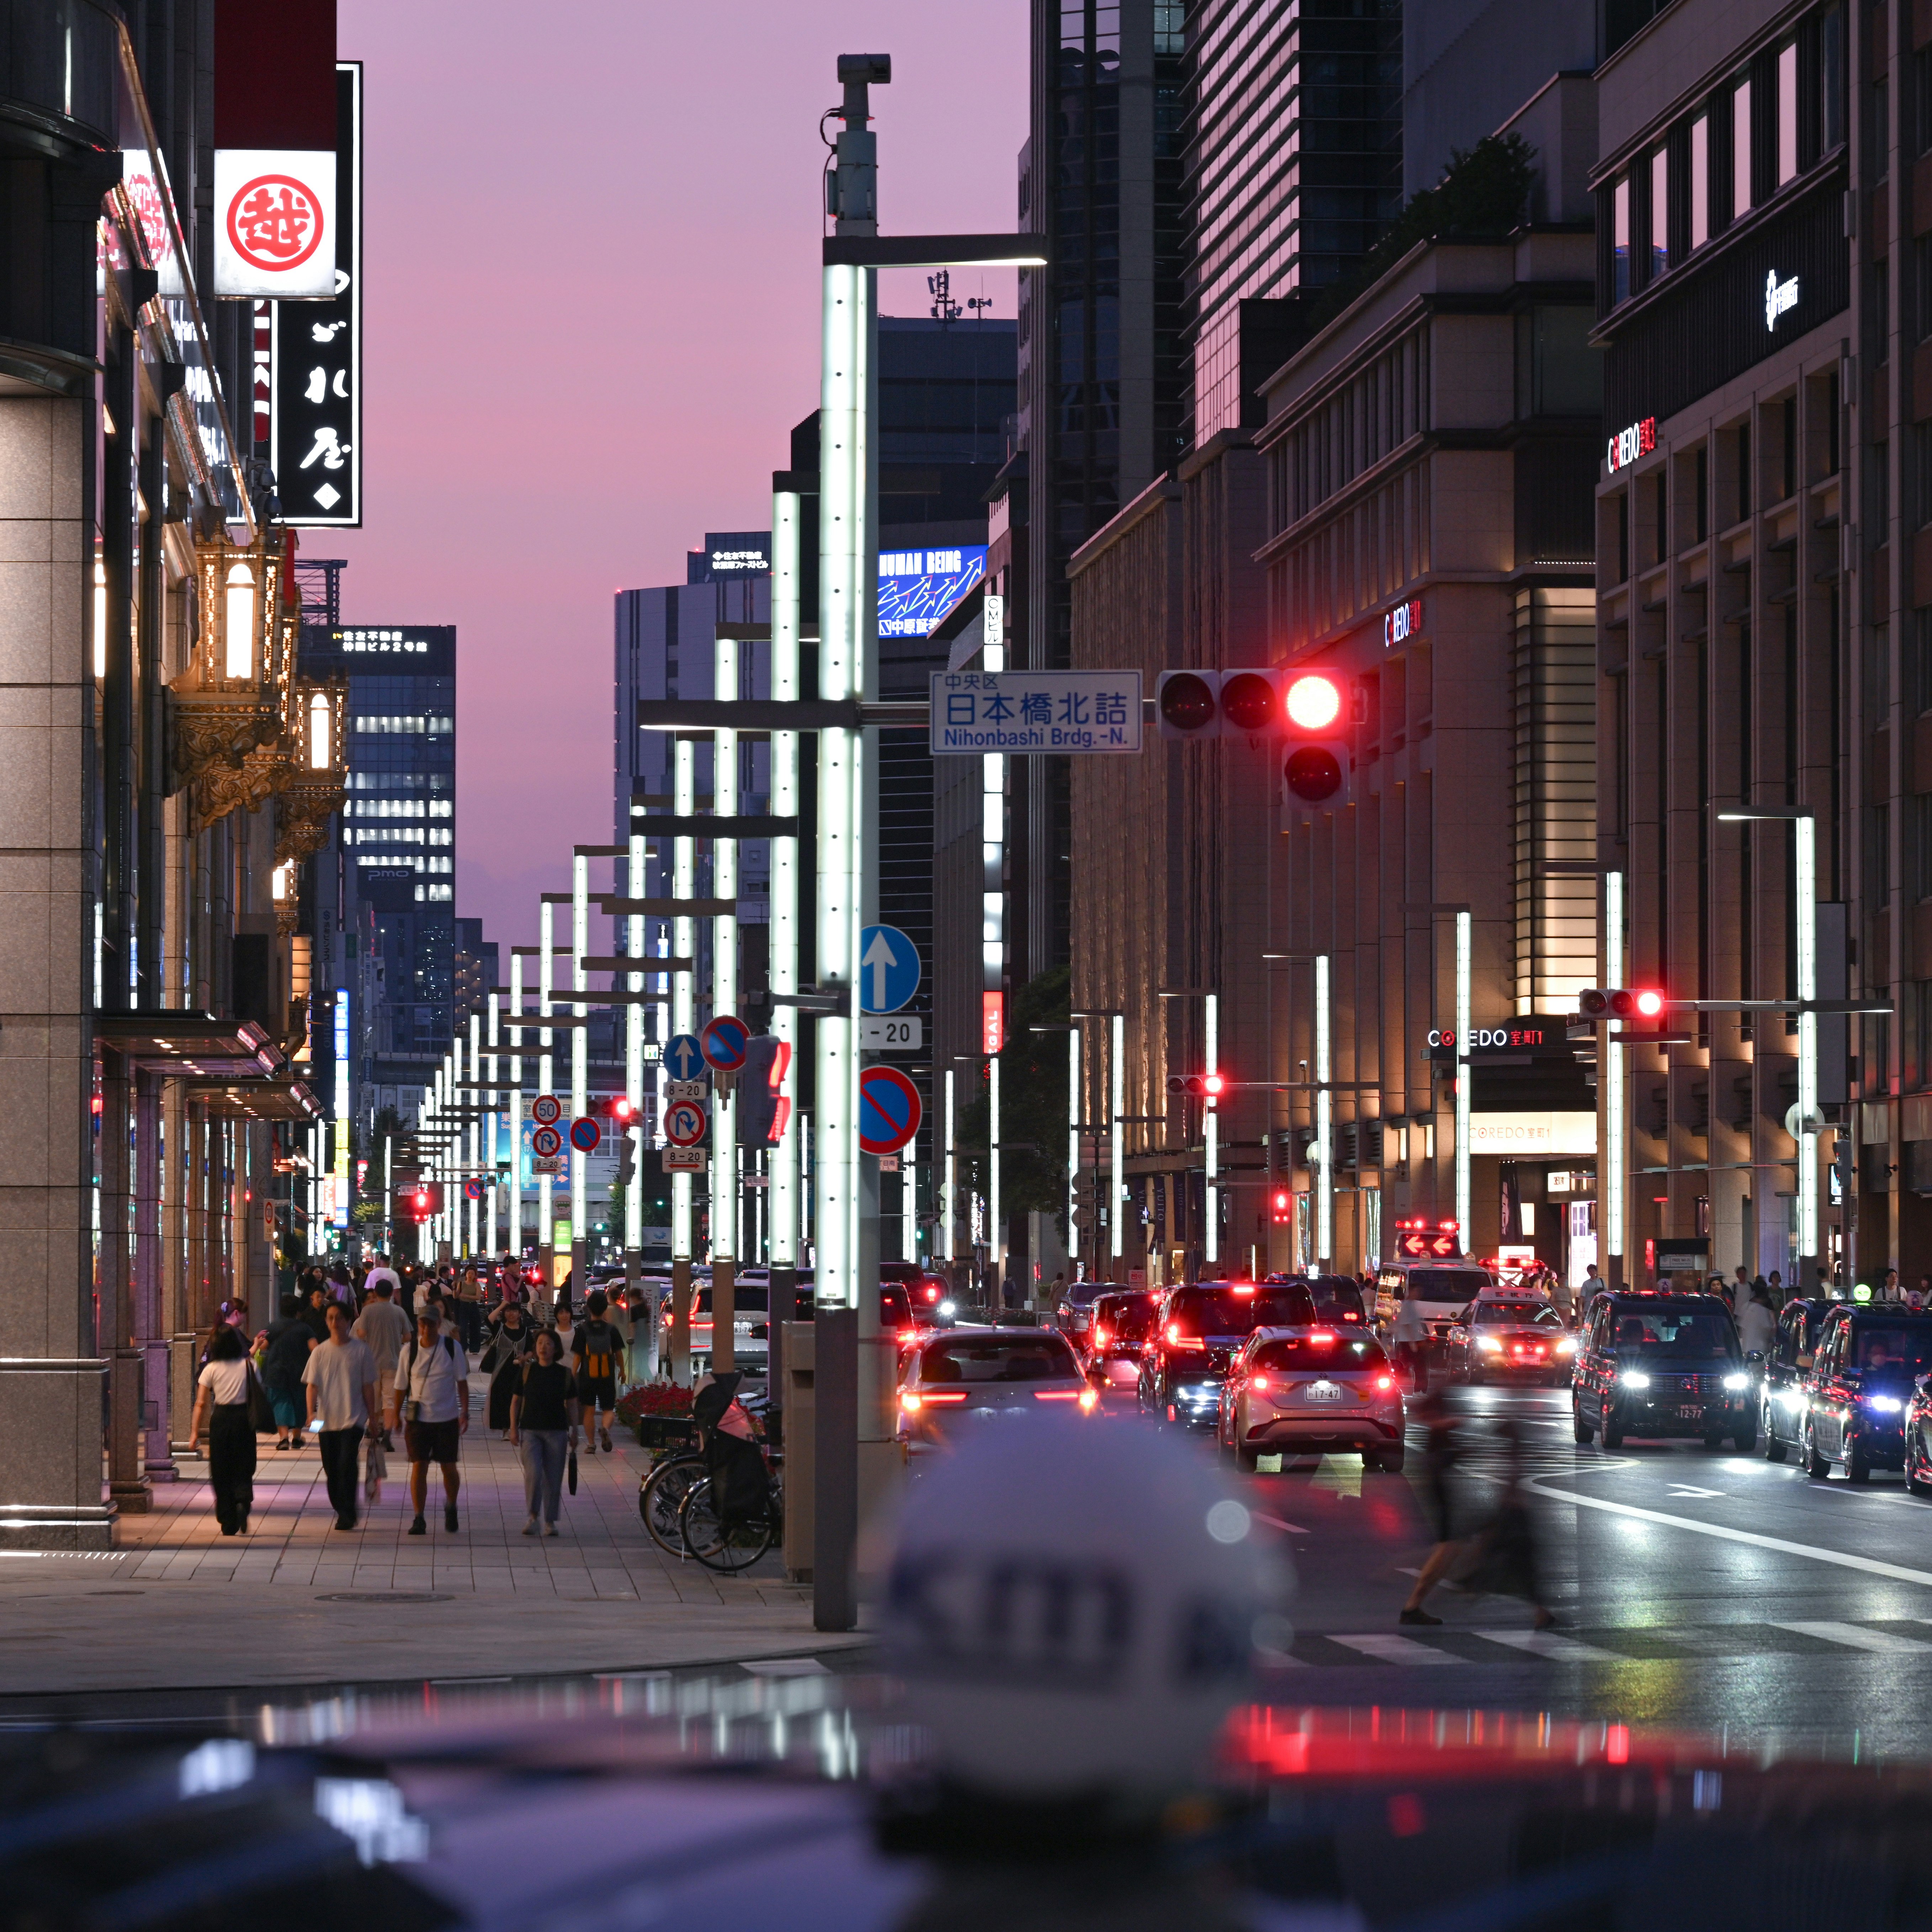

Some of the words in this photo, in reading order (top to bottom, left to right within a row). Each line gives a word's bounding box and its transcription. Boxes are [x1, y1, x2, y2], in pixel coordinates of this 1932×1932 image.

[1608, 423, 1640, 473] COREDO
[879, 553, 922, 577] HUMAN
[927, 550, 961, 574] BEING
[988, 598, 1001, 642] CMビル
[1385, 603, 1410, 647] COREDO
[945, 674, 998, 690] 中央区
[947, 692, 1127, 726] 日本橋北詰
[945, 728, 1044, 745] Nihonbashi
[860, 1023, 910, 1042] -20
[1428, 1029, 1507, 1047] COEDO
[539, 1103, 554, 1117] 50
[1469, 1127, 1524, 1138] COREDO
[1316, 1390, 1338, 1398] 17-47
[1681, 1410, 1702, 1418] 12-77
